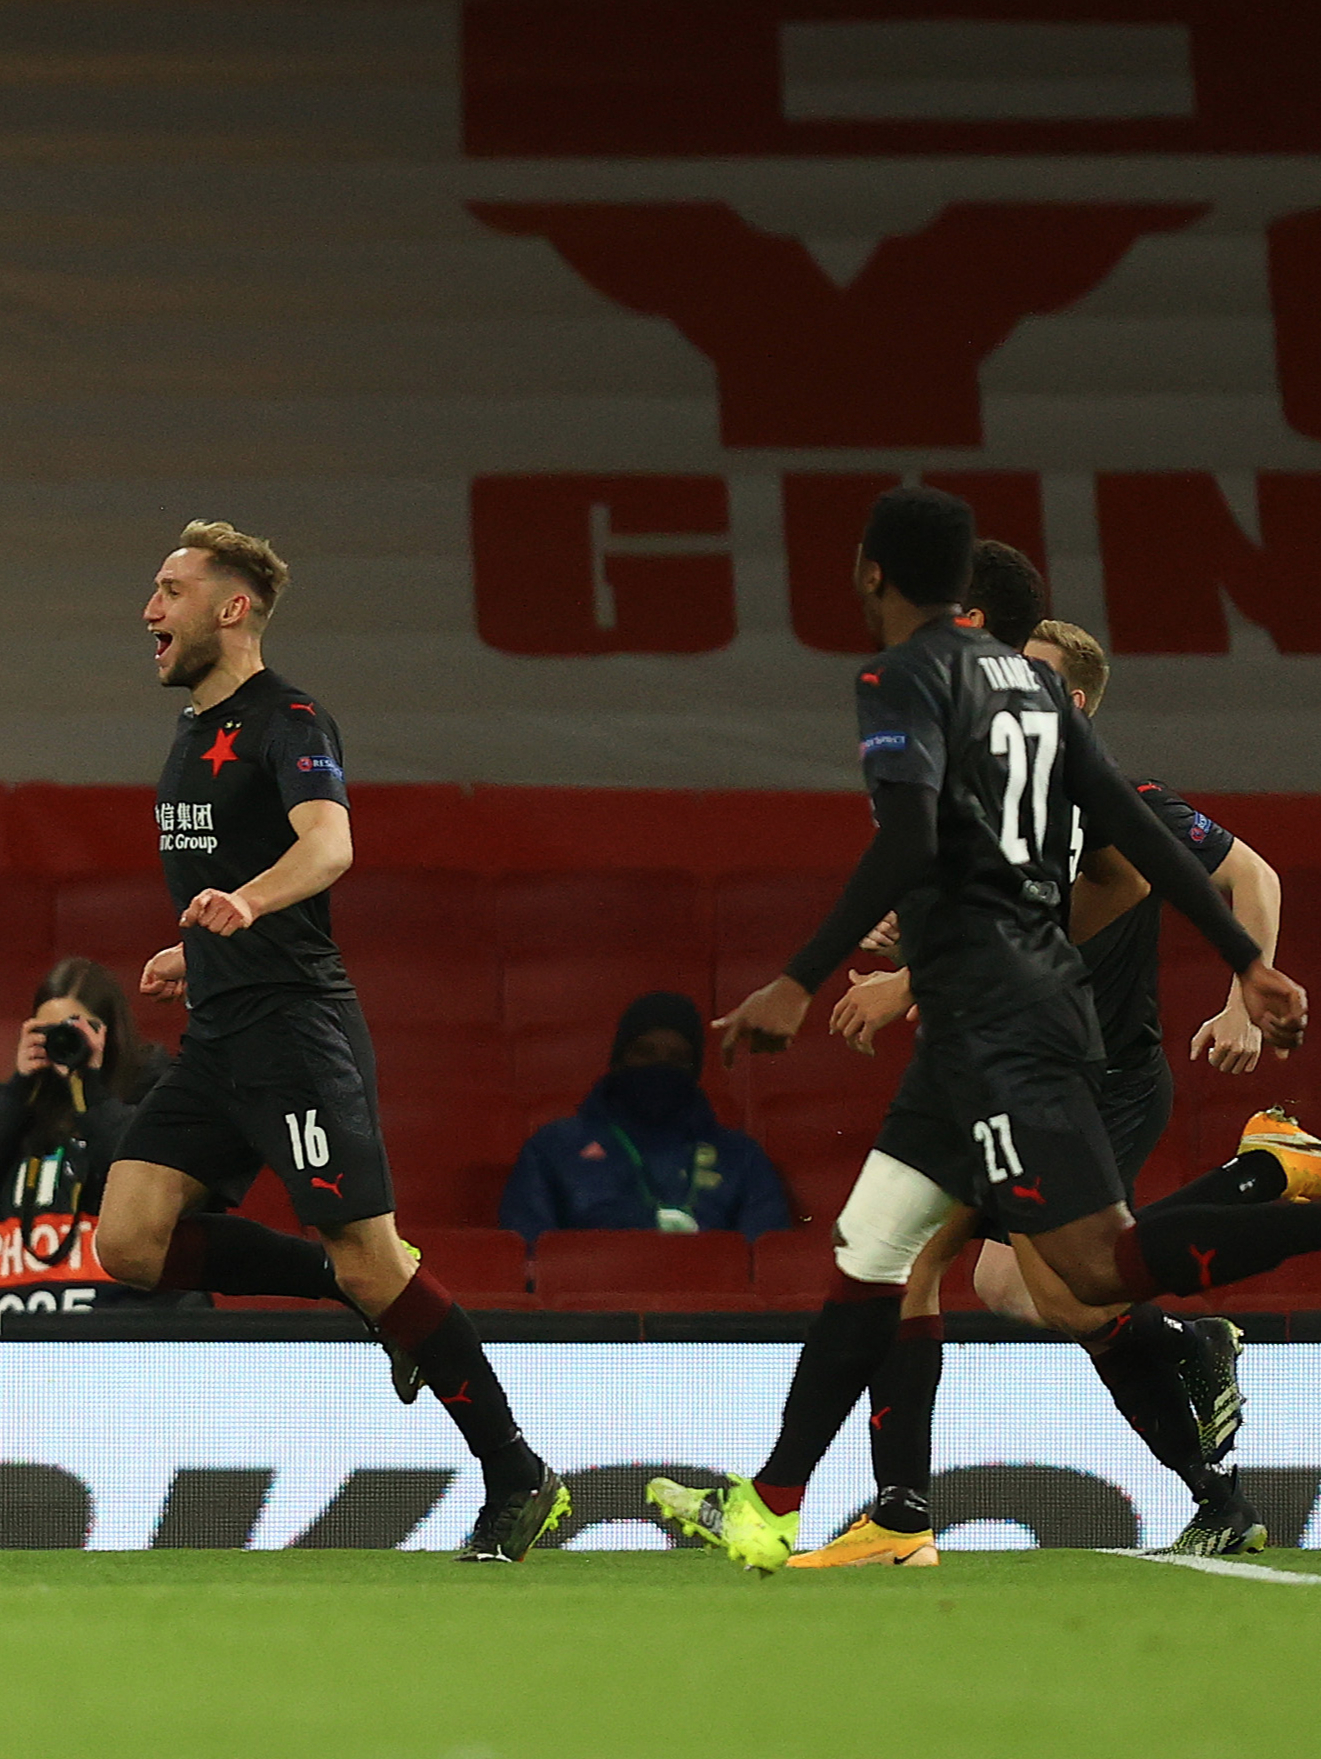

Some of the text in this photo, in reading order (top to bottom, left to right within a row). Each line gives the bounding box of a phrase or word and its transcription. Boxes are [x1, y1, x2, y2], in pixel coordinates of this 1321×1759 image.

[990, 711, 1059, 865] 27
[175, 833, 218, 854] Group
[285, 1109, 330, 1171] 16
[973, 1112, 1024, 1184] 27
